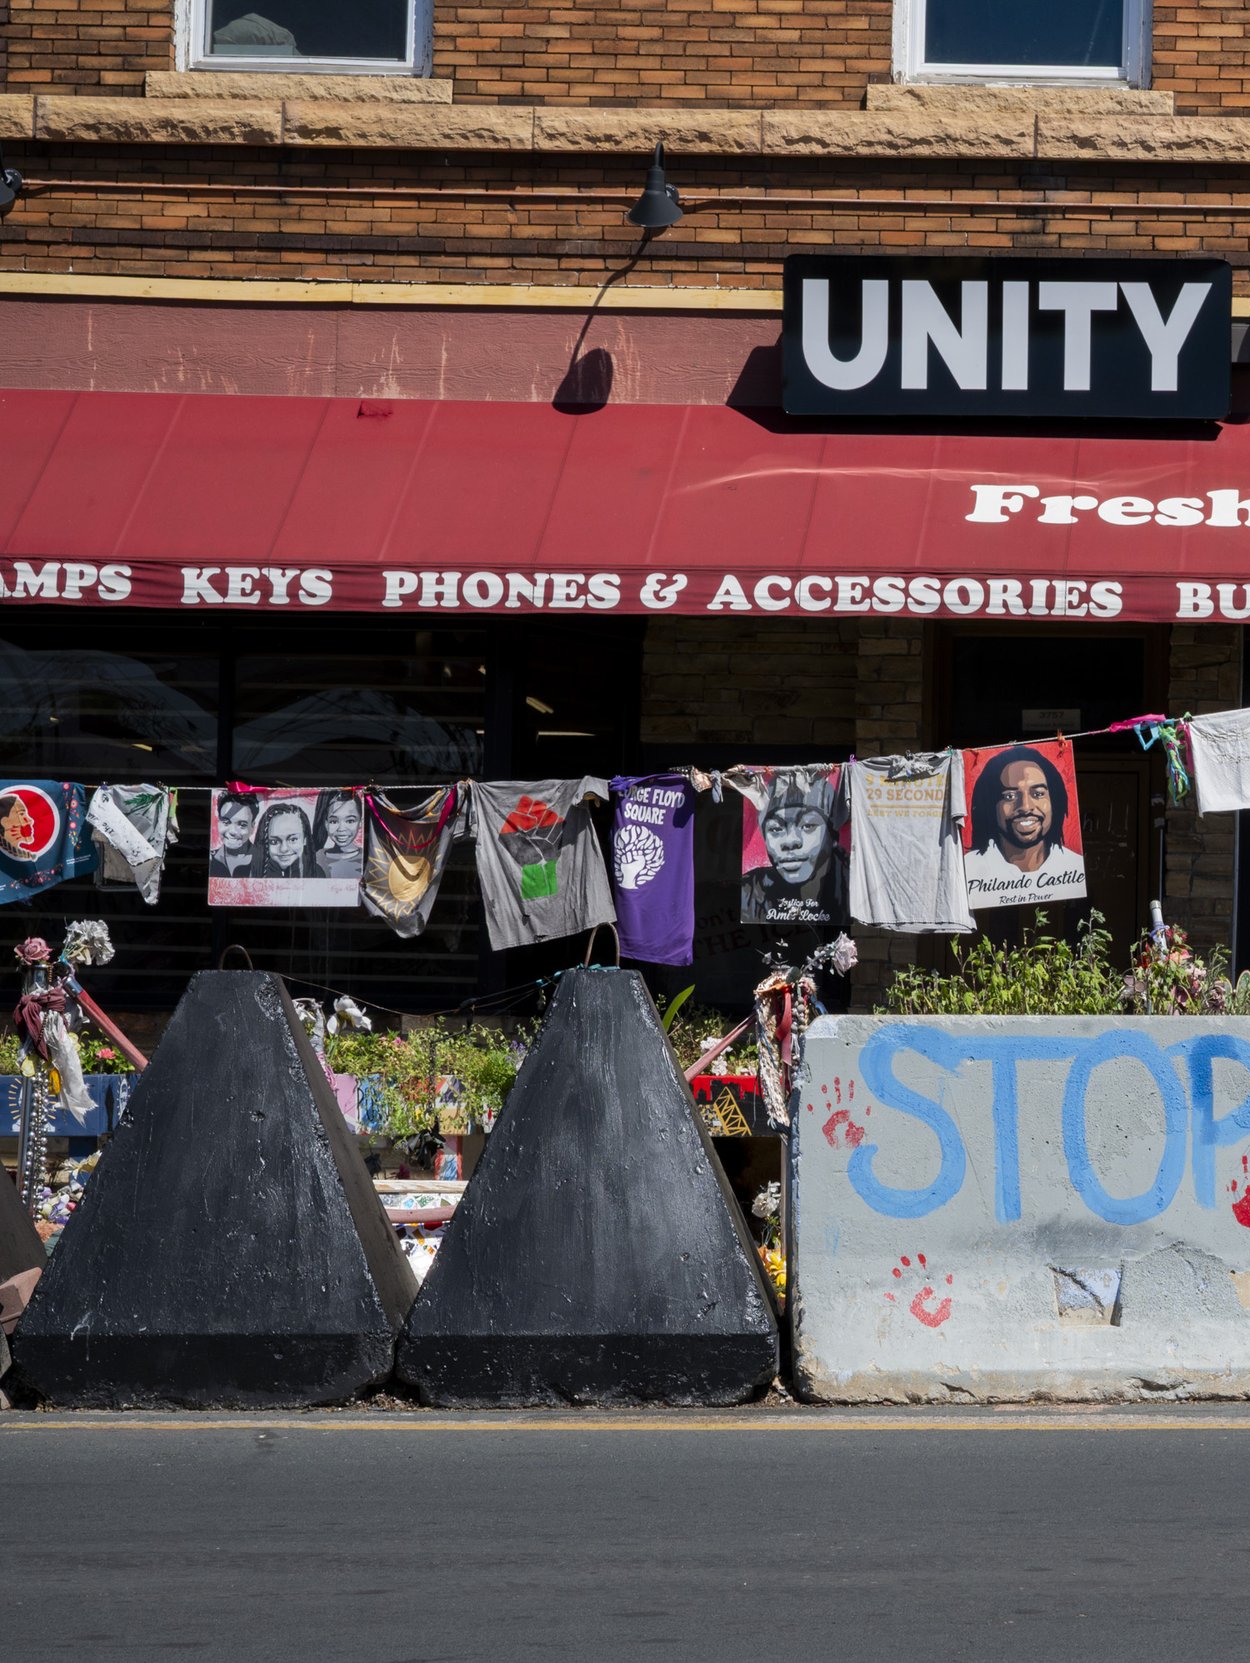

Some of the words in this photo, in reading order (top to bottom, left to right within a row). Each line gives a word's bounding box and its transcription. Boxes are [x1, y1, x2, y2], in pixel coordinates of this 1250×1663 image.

[803, 279, 1212, 391] UNITY
[180, 567, 333, 605] KEYS
[382, 571, 621, 609] PHONES
[640, 572, 688, 609] &
[706, 574, 1123, 618] ACCESSORIES
[652, 788, 685, 808] FLOYD
[866, 788, 882, 800] 29
[887, 789, 943, 801] SECOND
[624, 802, 666, 825] SQUARE
[968, 875, 1032, 895] Philando
[1036, 870, 1085, 889] Castile
[999, 895, 1016, 905] Rest
[1018, 895, 1026, 903] in
[1028, 893, 1053, 903] Power
[799, 909, 830, 921] Locke
